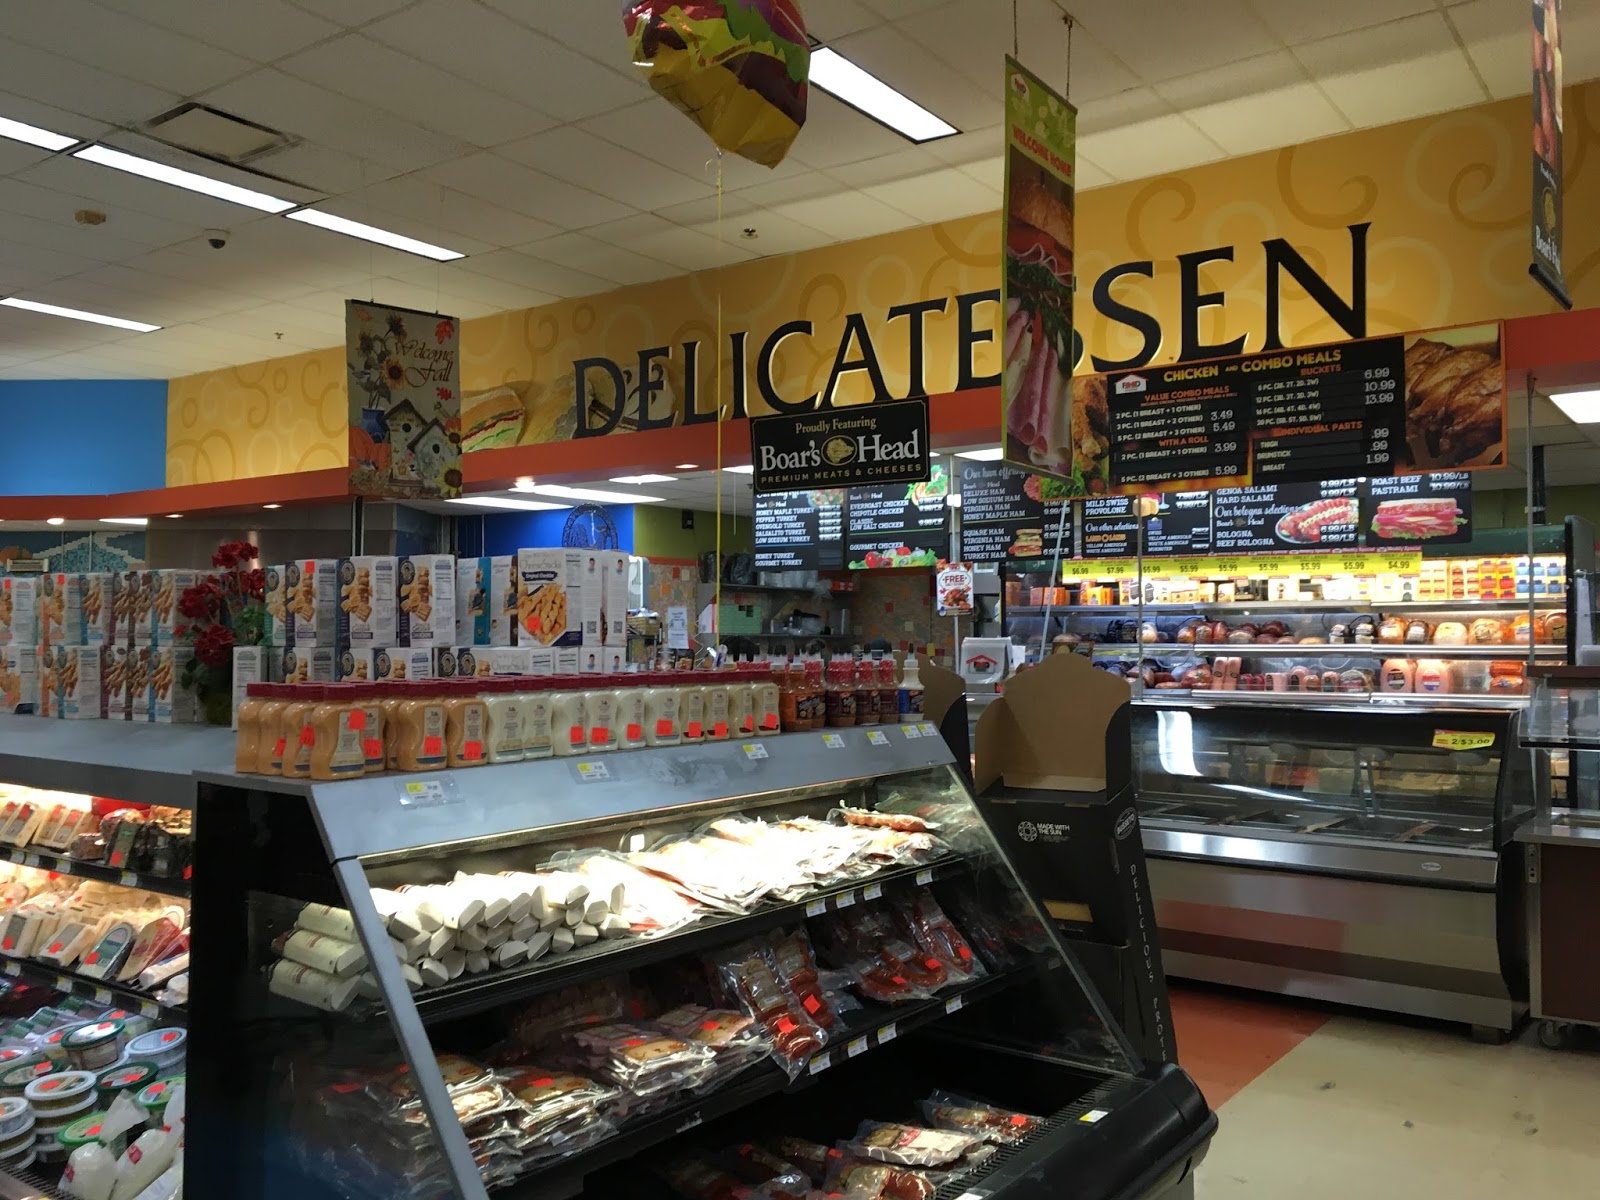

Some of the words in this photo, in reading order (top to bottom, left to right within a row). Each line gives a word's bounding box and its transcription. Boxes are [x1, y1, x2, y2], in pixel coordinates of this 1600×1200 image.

[1013, 124, 1049, 161] WELCOME
[1050, 152, 1072, 177] HOME
[573, 222, 1371, 439] DELICATESEN
[388, 340, 453, 362] Welcome
[1164, 365, 1218, 382] CHICKEN
[1241, 357, 1293, 373] COMBO
[1297, 350, 1341, 366] MEALS
[1301, 364, 1341, 376] BUCKETS
[405, 361, 453, 388] Fall
[1365, 368, 1389, 379] 6.99
[1365, 380, 1395, 392] 10.99
[1145, 392, 1169, 401] VALUE
[1171, 389, 1201, 399] COMBO
[1203, 386, 1230, 395] MEALS
[1365, 393, 1394, 404] 13.99
[1140, 408, 1165, 416] BREAST
[1211, 410, 1233, 420] 3.49
[796, 420, 830, 434] Proudly
[833, 416, 876, 430] Featuring
[1213, 421, 1235, 431] 5.49
[1280, 424, 1329, 436] INDIVIDUAL
[1332, 421, 1363, 431] PARTS
[1142, 430, 1167, 438] BREAST
[1372, 428, 1389, 438] .99
[1159, 438, 1179, 447] WITH
[1189, 436, 1208, 444] ROLL
[760, 440, 820, 471] Boar's
[857, 429, 920, 462] Head
[1145, 450, 1170, 458] BREAST
[1214, 442, 1236, 452] 3.99
[1257, 451, 1291, 459] DRUMSTICK
[1370, 441, 1388, 451] .99
[1366, 453, 1389, 464] 1.99
[761, 474, 809, 483] PREMIUM
[815, 470, 850, 479] MEATS
[868, 464, 921, 475] CHEESES
[965, 468, 981, 479] Our
[1146, 472, 1171, 480] BREAST
[1215, 465, 1237, 475] 5.99
[1372, 477, 1399, 486] ROAST
[1401, 475, 1422, 483] BEEF
[1372, 485, 1418, 495] PASTRAMI
[978, 496, 1004, 504] SODIUM
[1086, 499, 1104, 507] MILD
[1106, 498, 1128, 506] SWISS
[1241, 494, 1274, 502] SALAMI
[850, 502, 882, 510] EVERROAST
[1086, 507, 1126, 515] PROVOLONE
[1215, 506, 1232, 518] Our
[1234, 506, 1262, 520] bologna
[1264, 504, 1301, 514] selections
[1085, 523, 1098, 532] Our
[1099, 523, 1113, 532] other
[1217, 530, 1253, 538] BOLOGNA
[1238, 538, 1274, 546] BOLOGNA
[964, 552, 990, 560] TURKEY
[1219, 564, 1237, 572] $5.99
[1344, 562, 1364, 570] $5.99
[1389, 561, 1409, 569] $4.99
[945, 575, 964, 583] FREE
[1130, 863, 1154, 982] DELICIOUS
